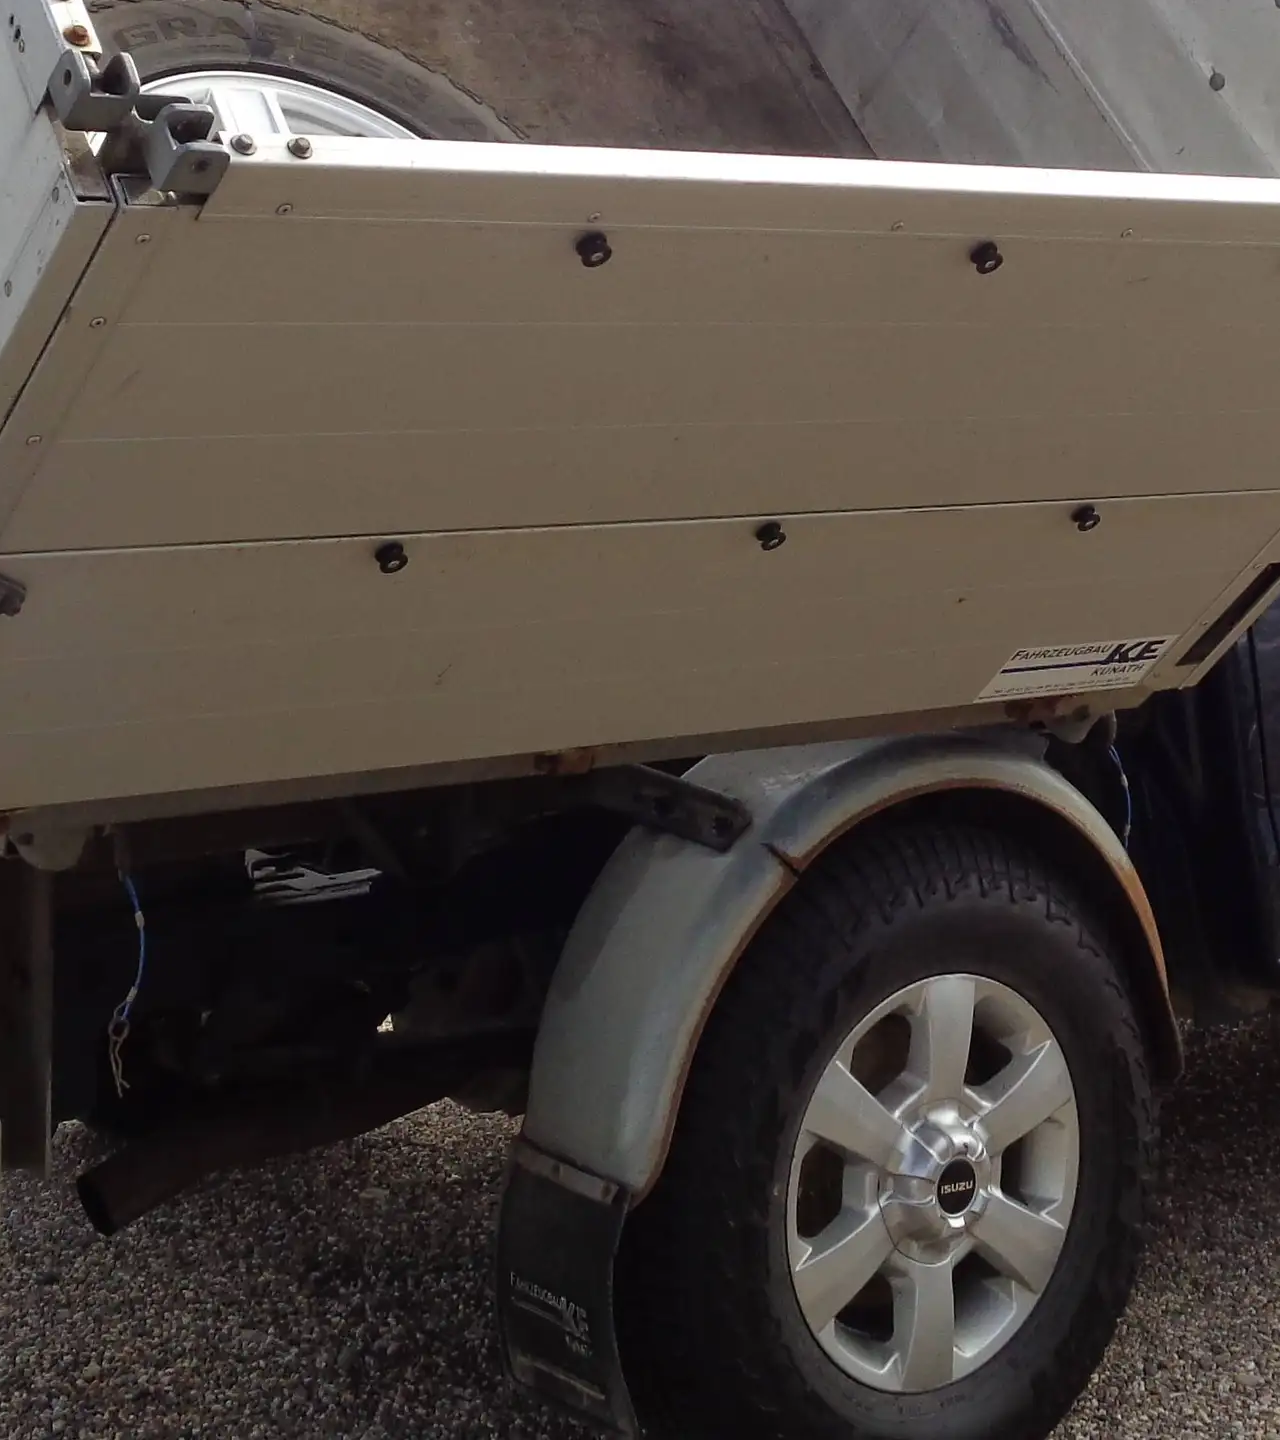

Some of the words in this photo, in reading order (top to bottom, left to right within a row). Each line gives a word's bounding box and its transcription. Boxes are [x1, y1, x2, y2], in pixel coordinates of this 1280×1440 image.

[1010, 644, 1112, 662] FAHRZEUGBAU
[1104, 639, 1167, 664] KE
[1091, 663, 1145, 677] KUNATH
[941, 1180, 973, 1195] ISUZU
